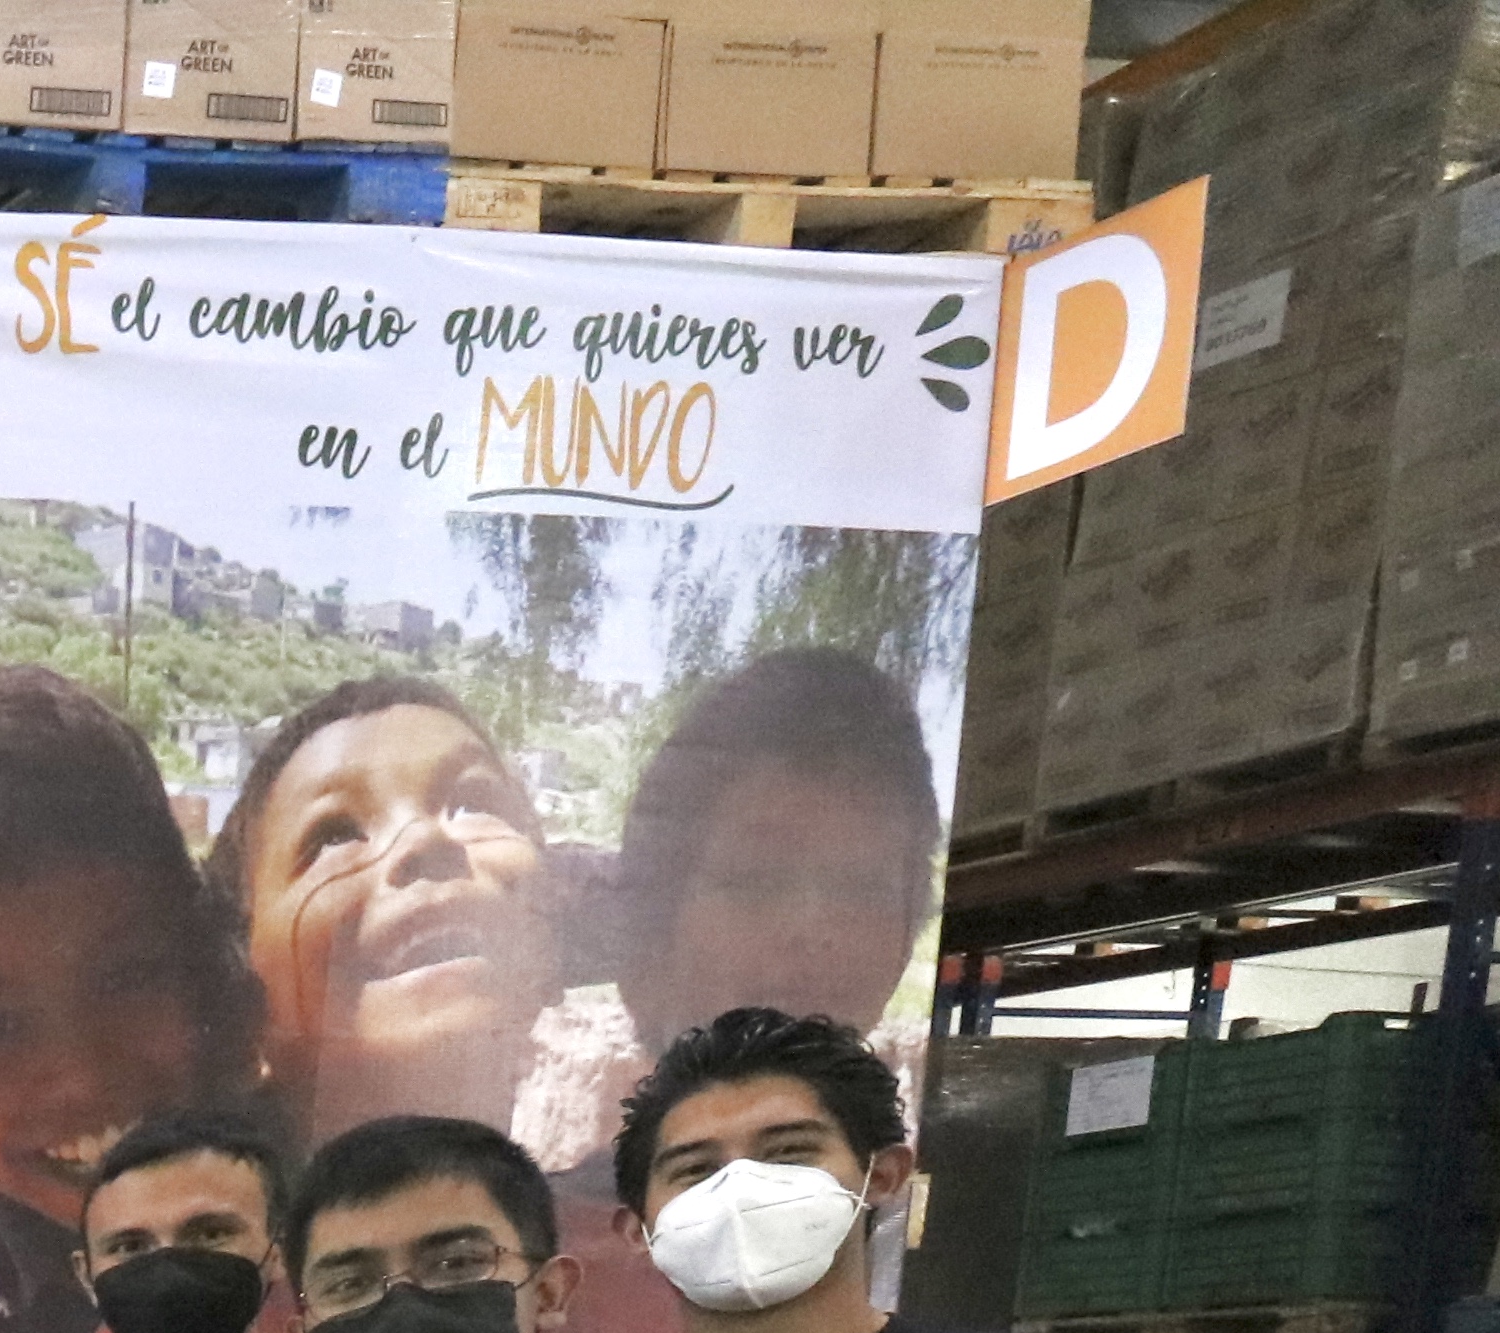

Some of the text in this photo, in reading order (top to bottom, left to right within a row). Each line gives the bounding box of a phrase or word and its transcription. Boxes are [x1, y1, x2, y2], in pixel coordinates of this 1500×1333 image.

[8, 34, 37, 49] ART
[188, 40, 217, 55] ART
[3, 50, 54, 67] GREEN
[352, 46, 378, 61] ART
[180, 55, 232, 73] GREEN
[346, 62, 393, 80] GREEN
[14, 213, 886, 383] SÉ el cambio que quieres ver
[1007, 234, 1166, 480] D
[297, 374, 717, 494] en el MUNDO
